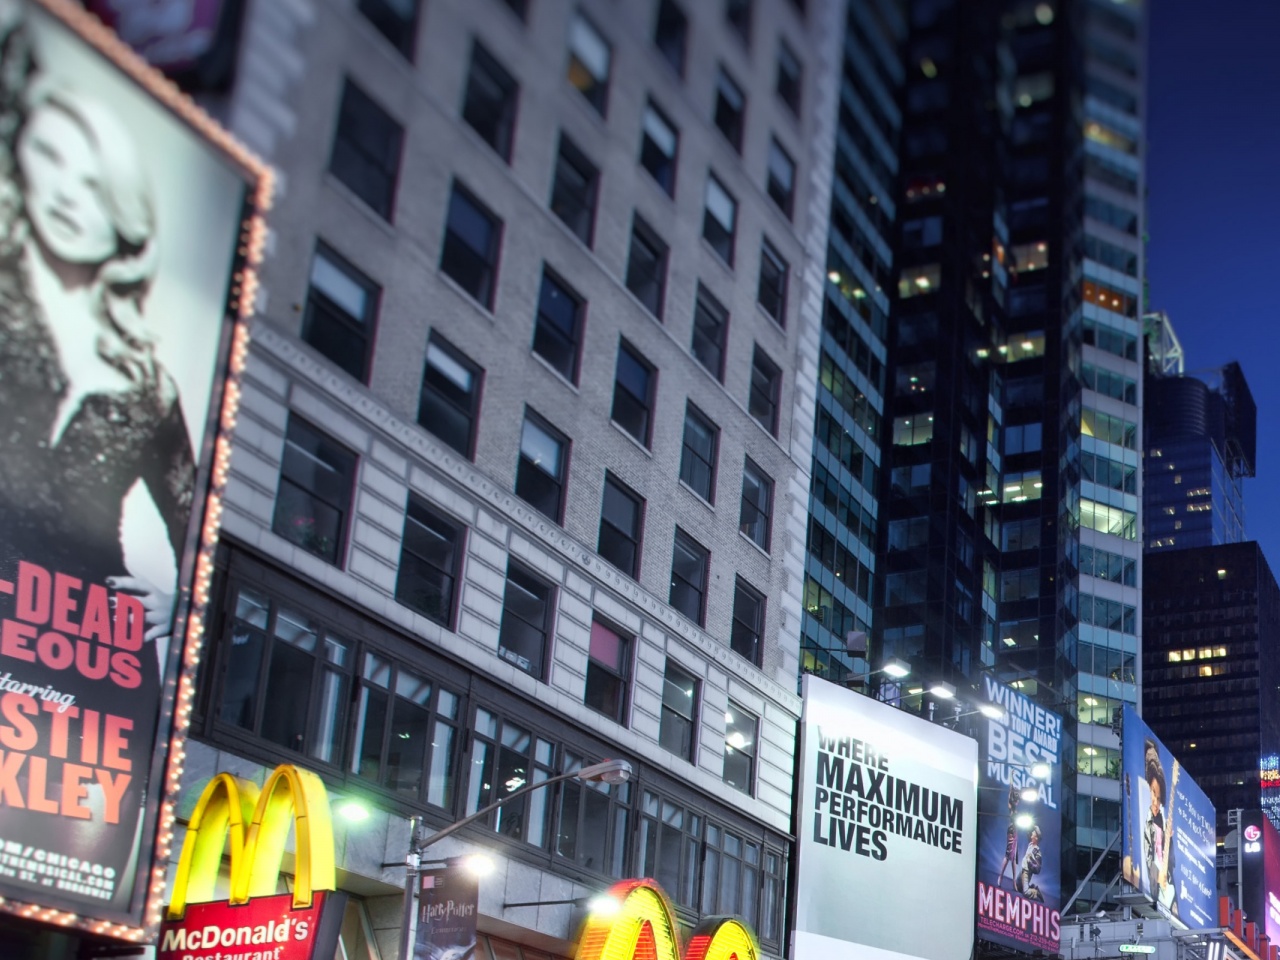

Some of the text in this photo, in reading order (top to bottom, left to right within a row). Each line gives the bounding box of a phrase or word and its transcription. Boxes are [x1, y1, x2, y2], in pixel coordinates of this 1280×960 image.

[985, 677, 1060, 739] WINNER!
[816, 724, 889, 772] WHERE
[988, 720, 1057, 786] BEST
[814, 786, 963, 854] PERFORMANCE
[815, 751, 964, 831] MAXIMUM
[813, 812, 888, 862] LIVES
[161, 918, 308, 952] McDonald's
[978, 881, 1060, 941] MEMPHIS
